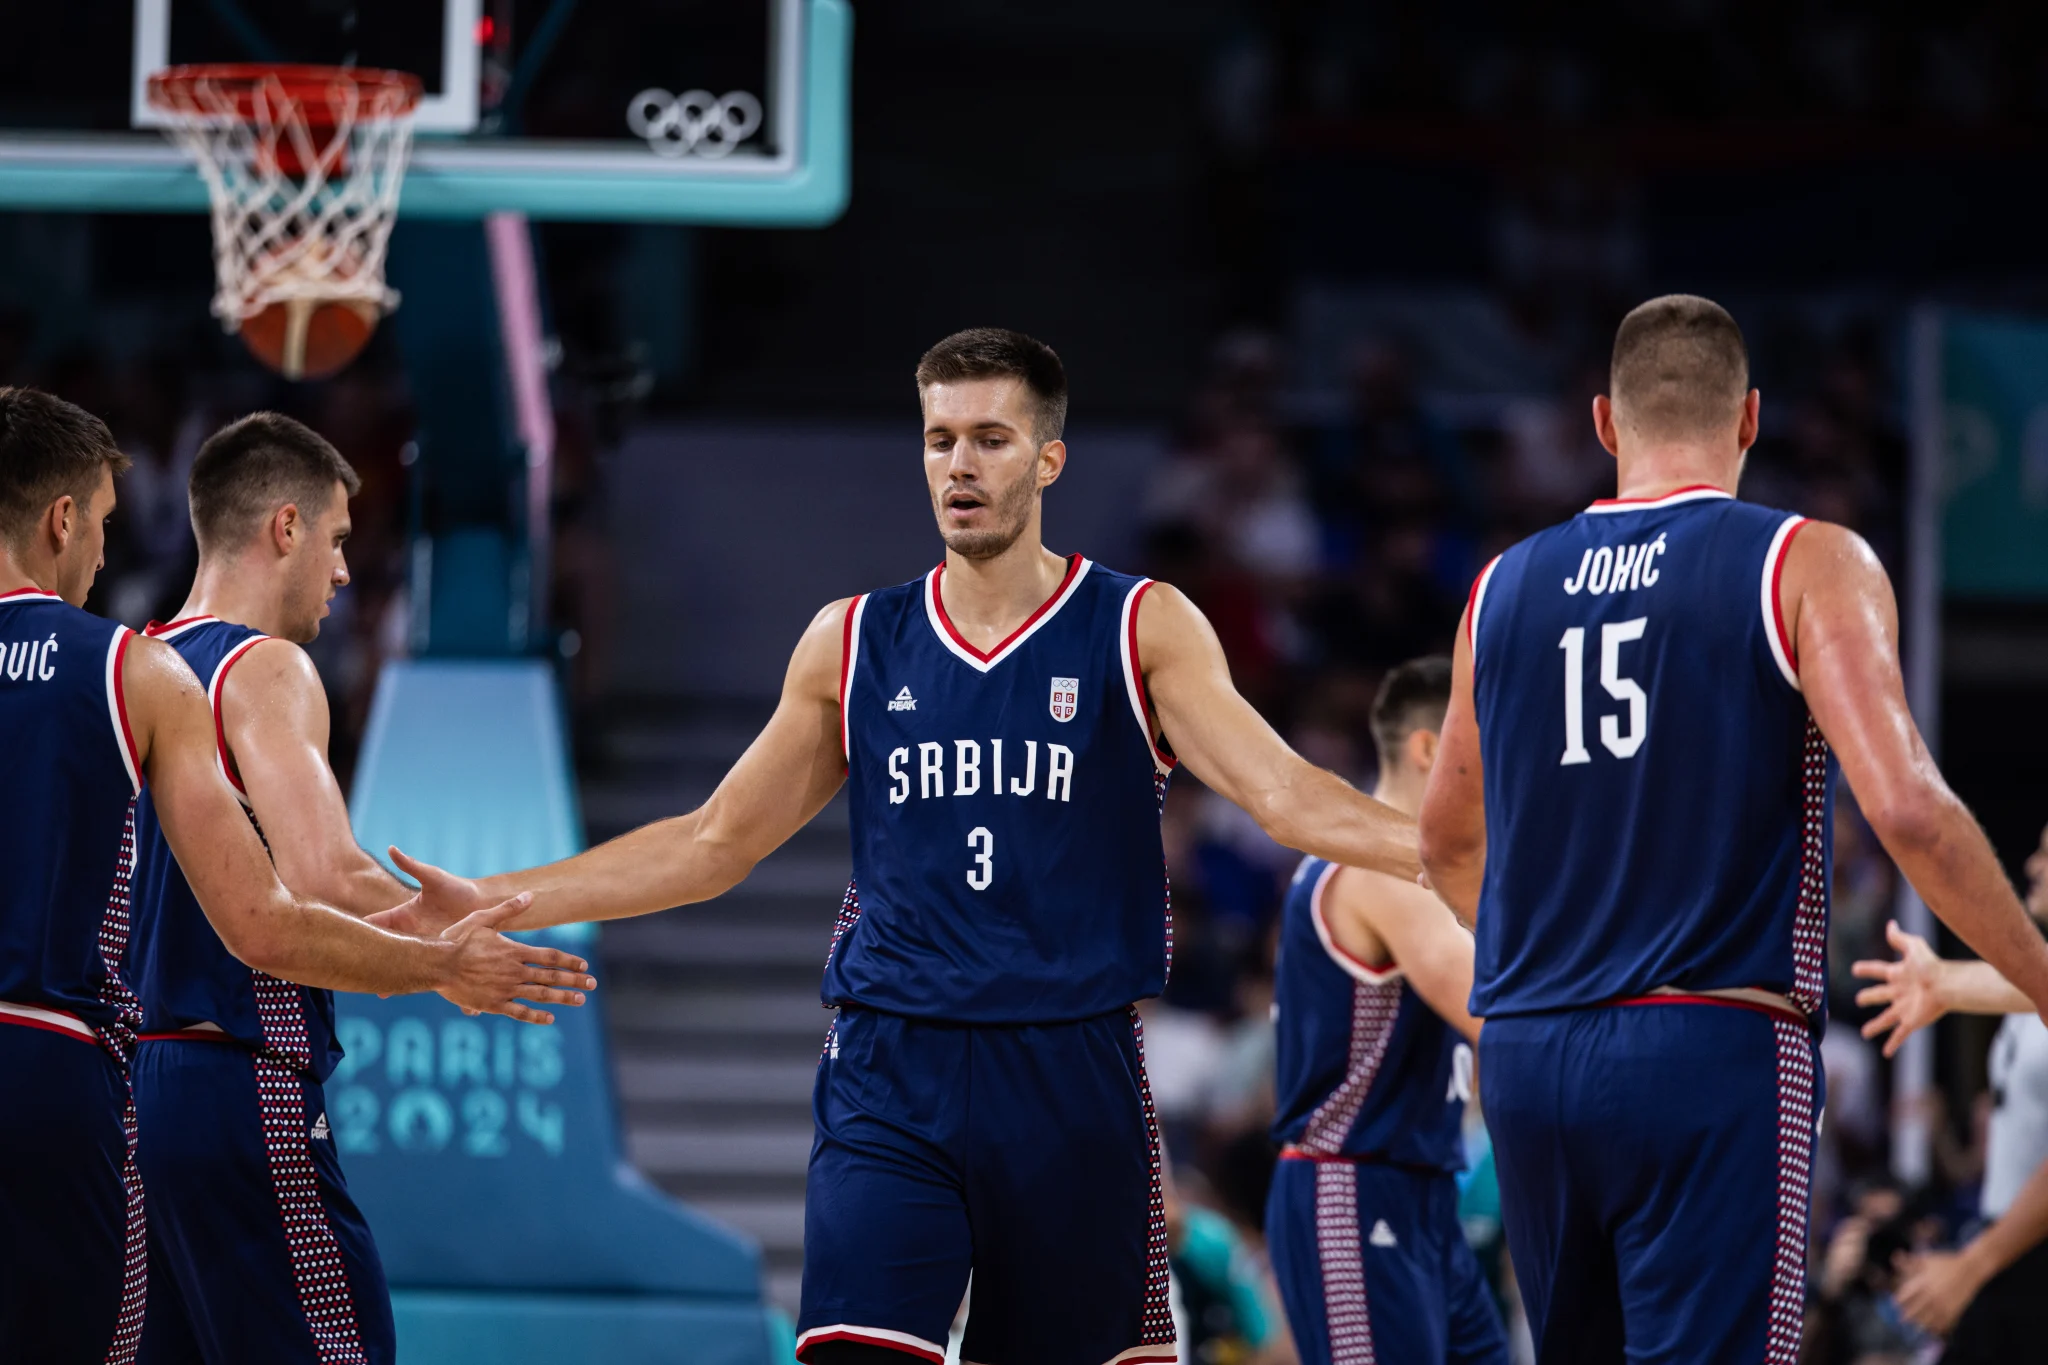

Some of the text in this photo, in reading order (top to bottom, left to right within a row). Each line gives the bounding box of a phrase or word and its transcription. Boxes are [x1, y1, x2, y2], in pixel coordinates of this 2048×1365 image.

[1563, 532, 1668, 595] JOKIĆ
[887, 699, 918, 711] PEAK
[1558, 616, 1648, 766] 15
[888, 739, 1074, 805] SRBIJA
[966, 826, 994, 891] 3
[336, 1017, 565, 1090] PARIS
[311, 1128, 330, 1140] PEAK
[334, 1085, 565, 1158] 2024
